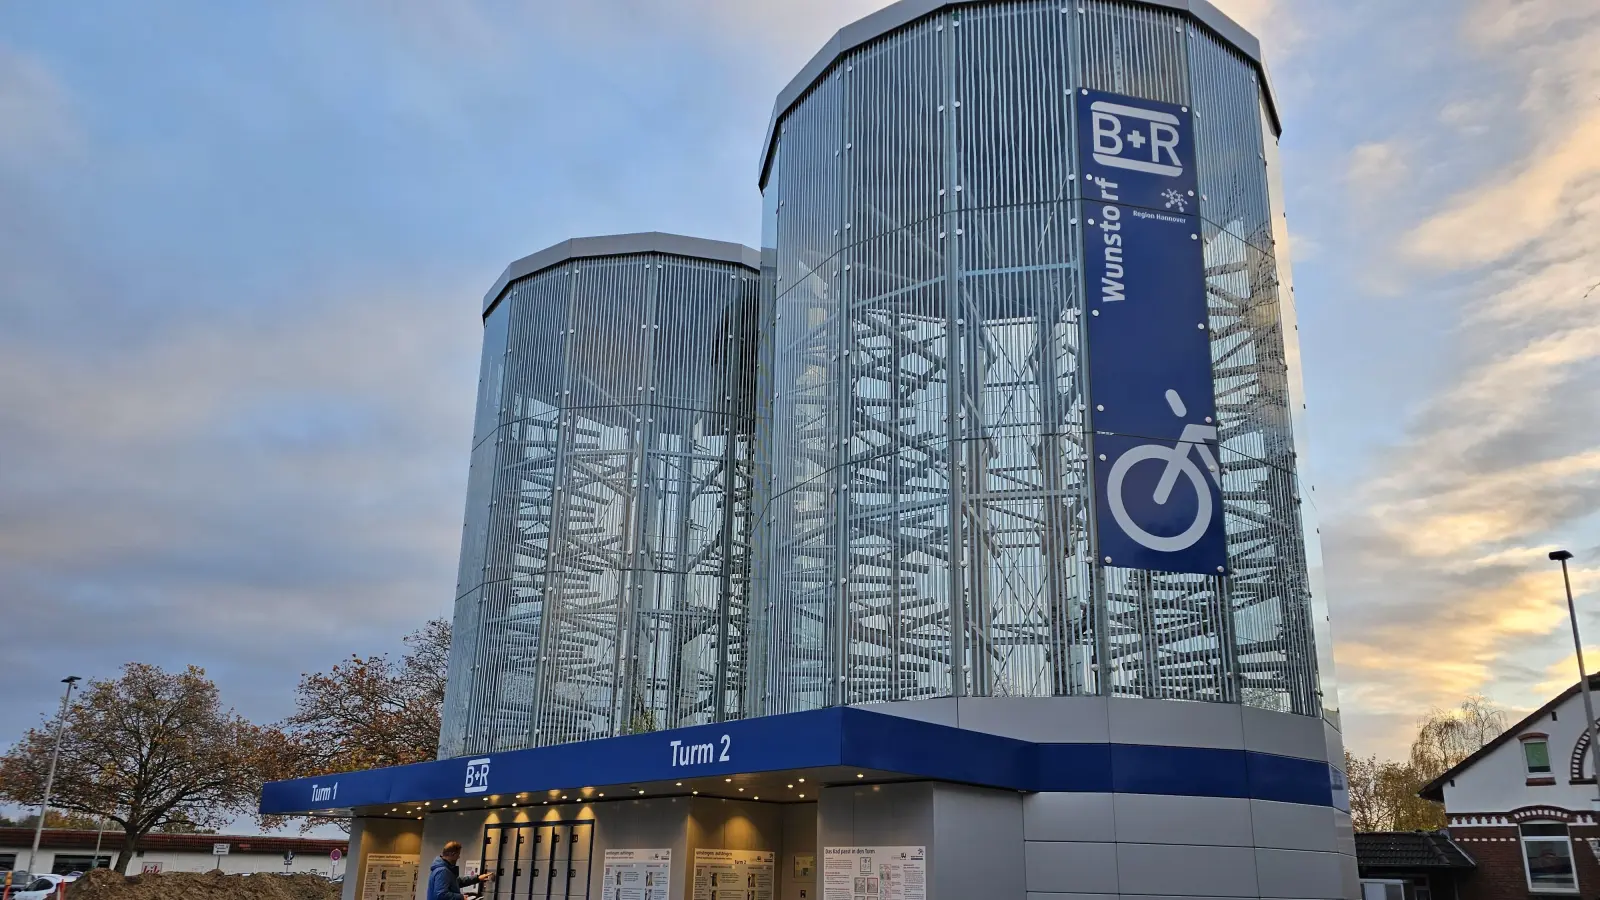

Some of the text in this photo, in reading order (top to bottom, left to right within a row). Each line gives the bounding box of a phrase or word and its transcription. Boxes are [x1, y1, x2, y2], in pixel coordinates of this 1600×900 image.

[1092, 111, 1183, 167] B+R
[1132, 209, 1187, 224] Region Hannover
[1094, 176, 1125, 303] Wunstorf
[670, 734, 731, 767] Turm 2
[464, 764, 490, 788] B+R
[311, 782, 338, 802] Turm 1
